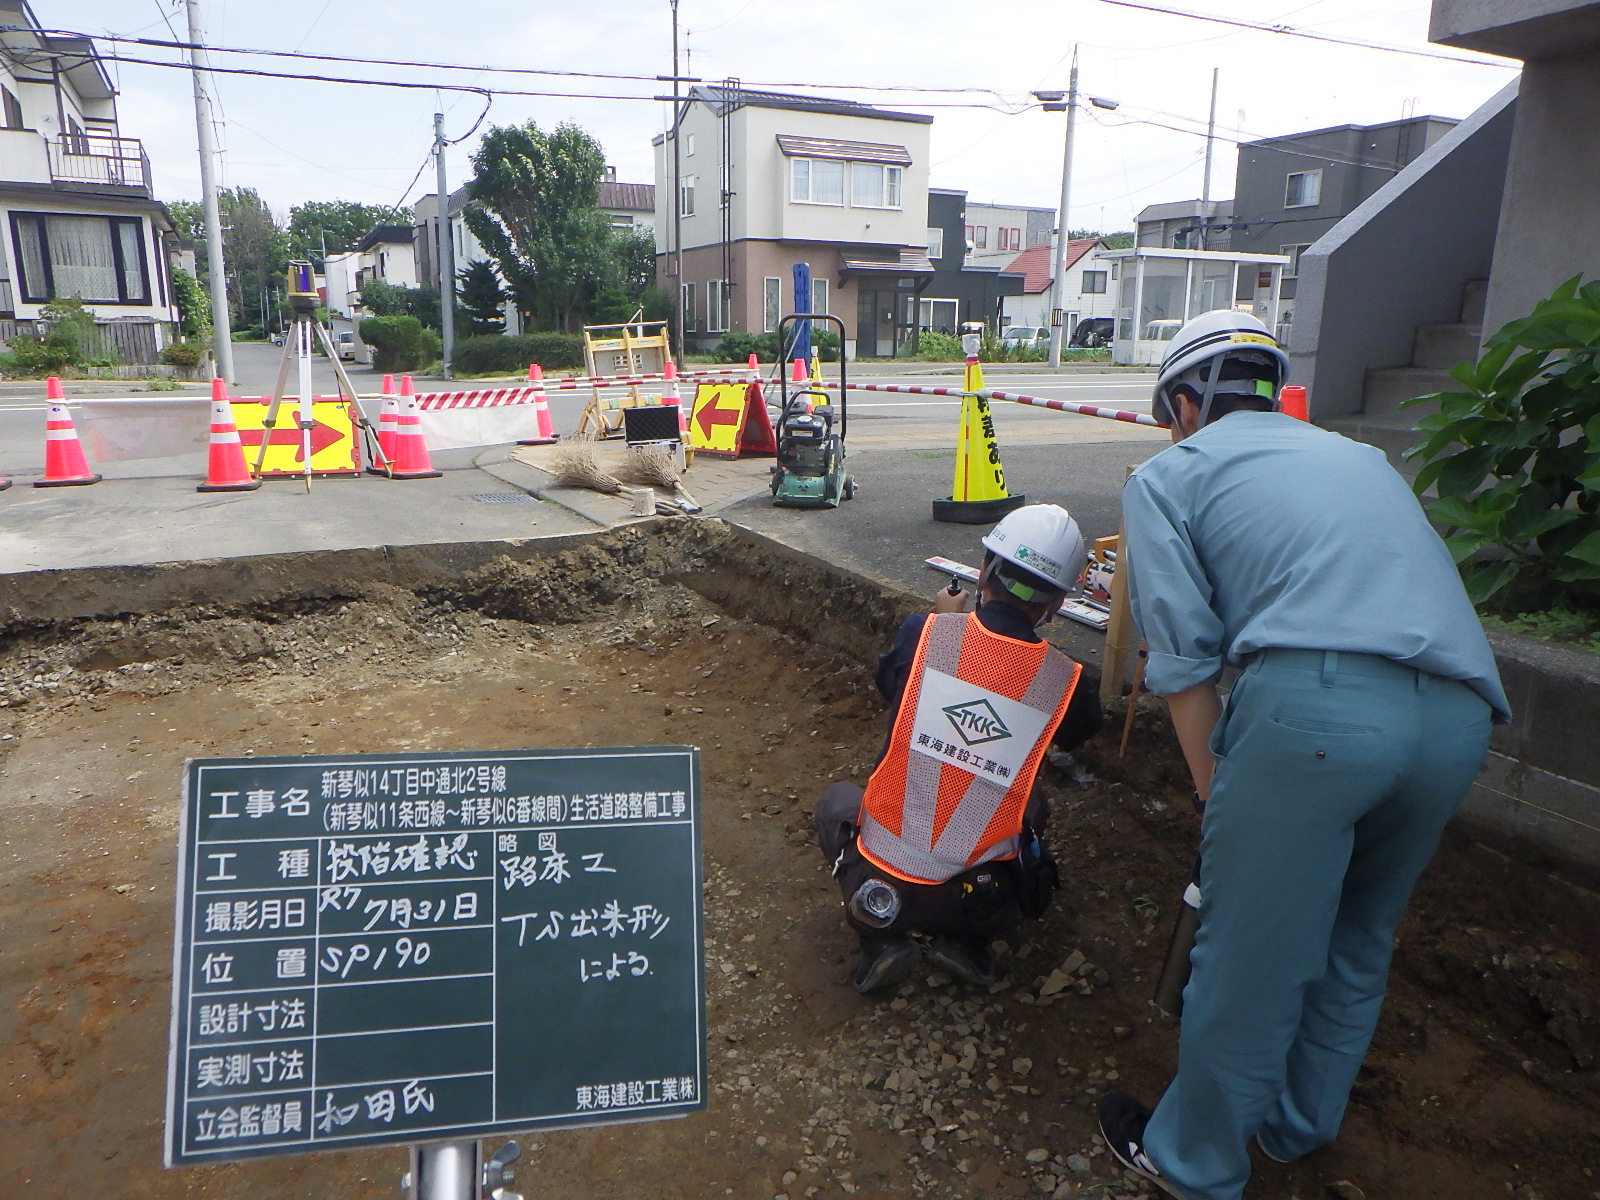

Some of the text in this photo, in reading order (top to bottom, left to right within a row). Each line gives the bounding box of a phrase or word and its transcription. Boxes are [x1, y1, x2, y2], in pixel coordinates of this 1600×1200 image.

[960, 708, 996, 737] TKK
[916, 732, 1012, 779] 東海建設工業(株)
[320, 765, 507, 799] 新琴似14丁目中通北2号線
[207, 787, 310, 819] 工事名
[325, 833, 479, 884] 段階確認
[499, 850, 617, 891] 路床工
[204, 898, 306, 933] 撮影月日
[362, 891, 478, 932] 7月31日
[320, 937, 431, 979] SP190
[199, 997, 306, 1036] 設計寸法
[196, 1049, 304, 1088] 実測寸法
[575, 1076, 696, 1111] 東海建設工業(株)
[194, 1101, 302, 1142] 立会監督員
